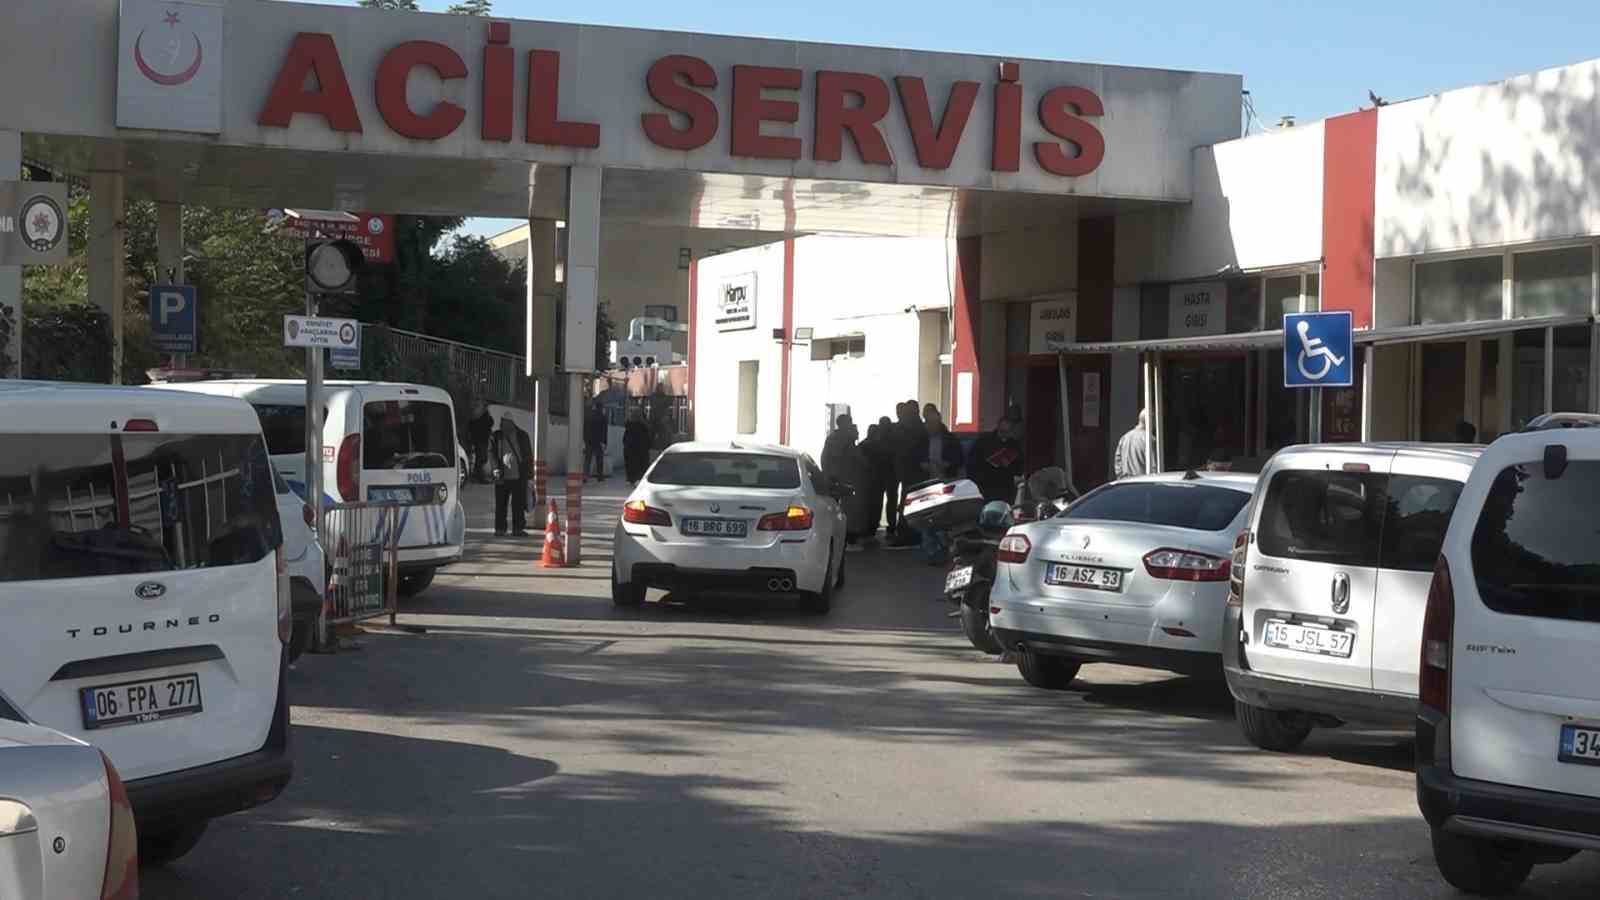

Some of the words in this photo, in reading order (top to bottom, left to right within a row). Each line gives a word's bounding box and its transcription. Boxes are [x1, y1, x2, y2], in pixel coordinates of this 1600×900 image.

[258, 22, 601, 150] ACİL
[641, 54, 1106, 176] SERVİS
[160, 292, 185, 324] P
[1184, 291, 1210, 305] HASTA
[1055, 566, 1067, 580] 16
[1072, 567, 1096, 583] ASZ
[1102, 571, 1118, 585] 53
[66, 613, 221, 638] TOURNEO
[1274, 626, 1288, 641] 15
[1295, 629, 1326, 648] JSL
[1330, 635, 1349, 651] 57
[97, 690, 117, 717] 06
[128, 685, 159, 713] FPA
[167, 679, 196, 707] 277
